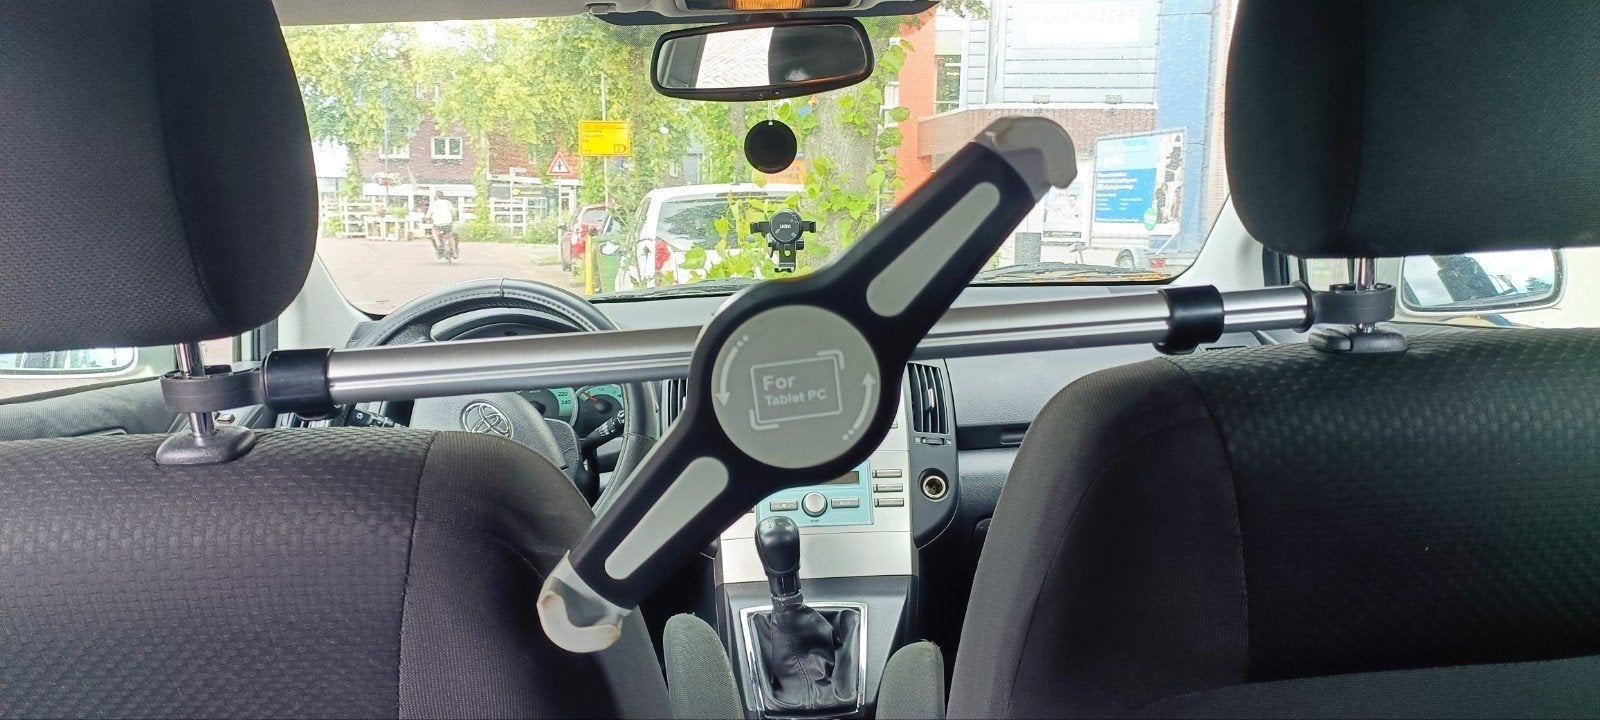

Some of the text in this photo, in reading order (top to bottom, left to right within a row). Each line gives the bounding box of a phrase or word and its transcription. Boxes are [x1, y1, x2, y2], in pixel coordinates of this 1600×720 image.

[762, 375, 796, 391] For
[763, 388, 827, 406] Tablet PC
